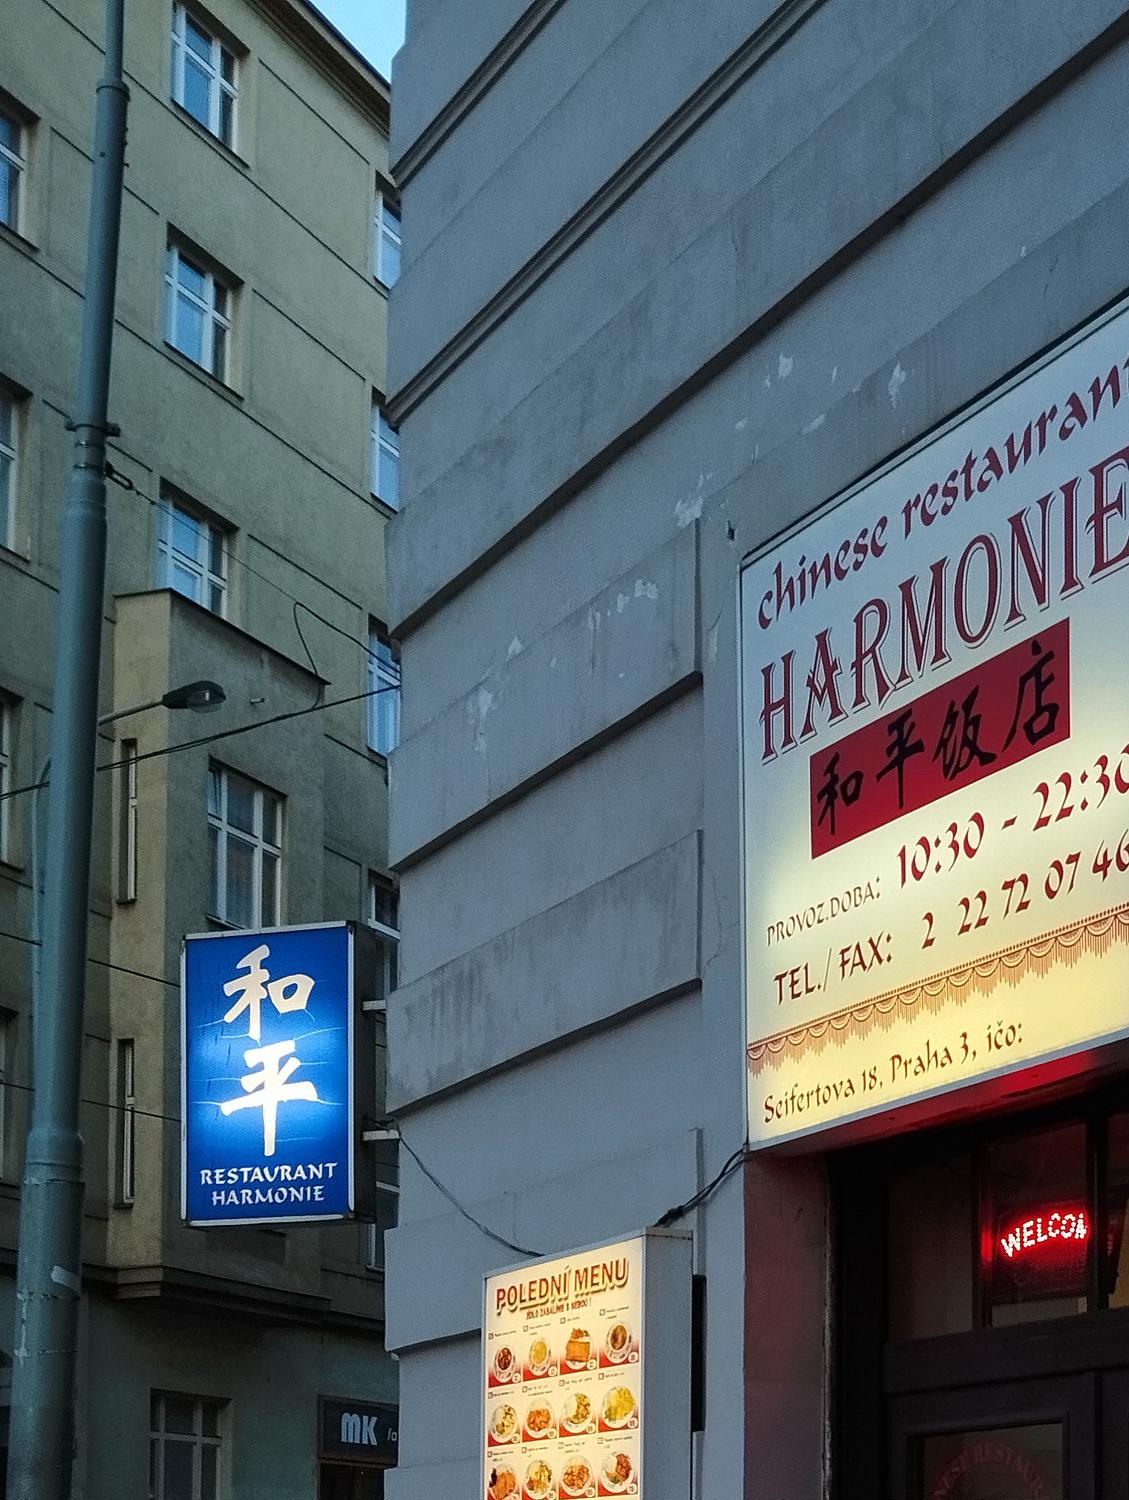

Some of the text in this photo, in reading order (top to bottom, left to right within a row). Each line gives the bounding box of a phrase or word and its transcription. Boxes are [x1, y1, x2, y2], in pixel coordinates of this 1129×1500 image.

[759, 515, 888, 630] chinese
[817, 640, 1060, 835] 和平饭店
[896, 812, 985, 888] 10:30
[1003, 815, 1017, 830] -
[839, 931, 892, 982] FAX:
[922, 912, 936, 949] 2
[957, 890, 988, 937] 22
[1001, 873, 1031, 920] 72
[1044, 852, 1082, 900] 07
[220, 944, 318, 1157] 和平
[764, 1083, 856, 1124] Seifertova
[891, 1040, 953, 1084] Praha
[200, 1162, 338, 1185] RESTAURANT
[211, 1185, 325, 1206] HARMONIE
[496, 1264, 571, 1315] POLEDNÍ
[574, 1257, 629, 1294] MENU
[341, 1412, 378, 1446] MK
